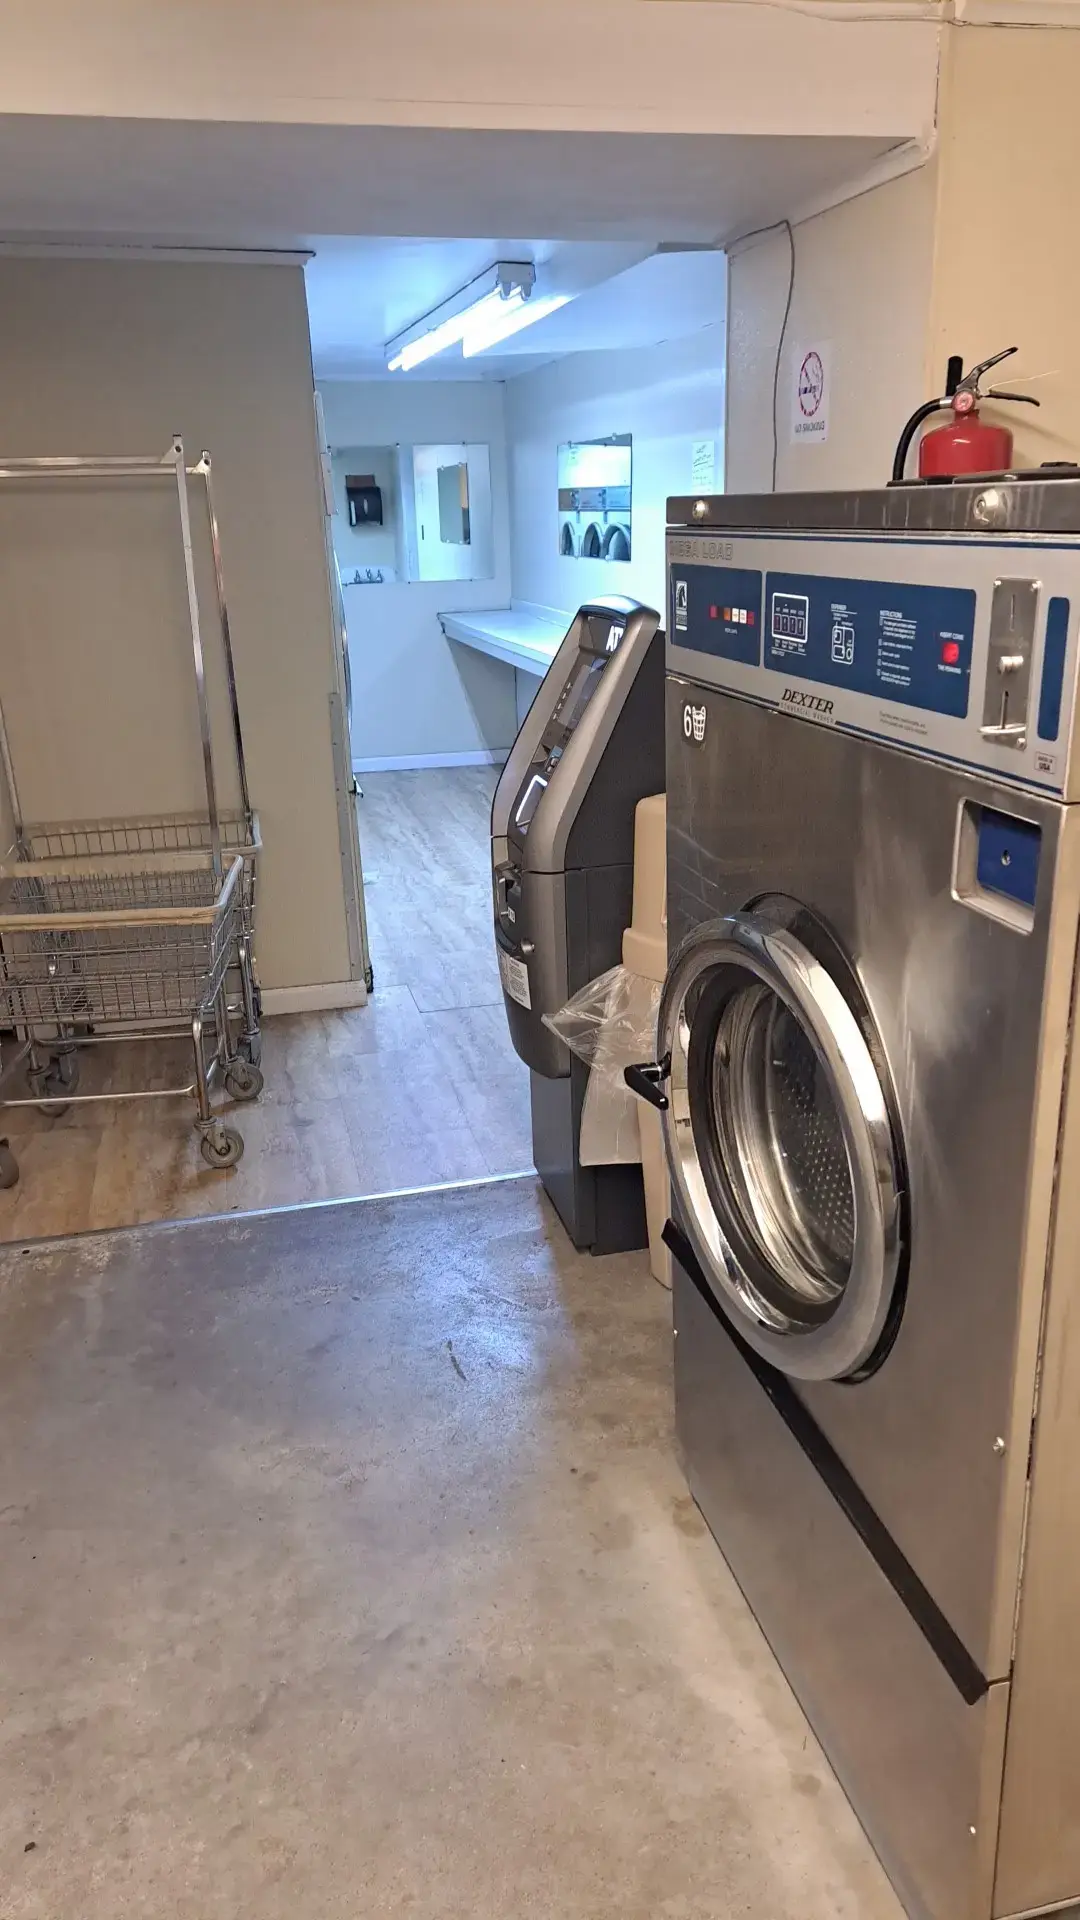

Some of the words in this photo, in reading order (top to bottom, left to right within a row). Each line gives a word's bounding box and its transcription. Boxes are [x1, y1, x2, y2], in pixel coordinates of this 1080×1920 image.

[802, 420, 825, 432] SMOKING
[702, 541, 734, 561] LOAD
[781, 688, 835, 715] DEXTER
[683, 704, 692, 737] 6
